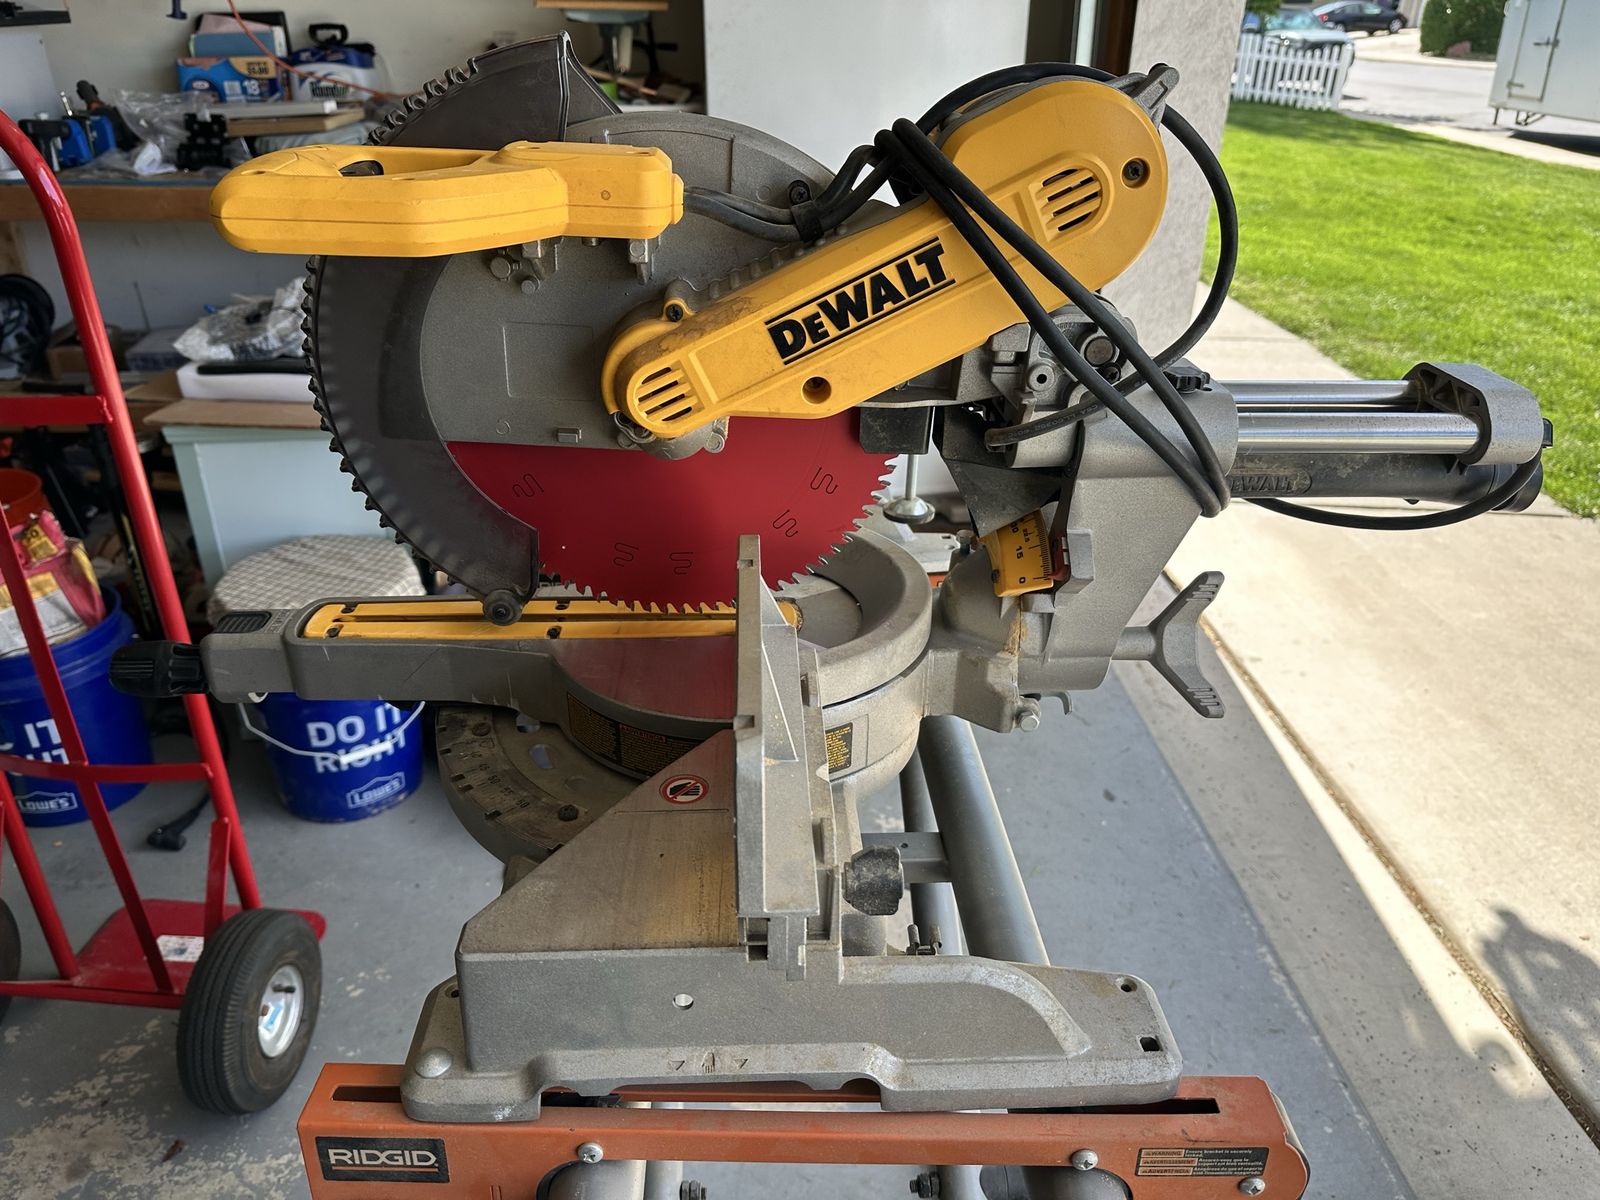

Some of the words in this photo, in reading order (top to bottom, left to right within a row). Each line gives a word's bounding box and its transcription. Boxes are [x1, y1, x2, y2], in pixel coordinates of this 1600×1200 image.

[243, 80, 260, 95] 18
[767, 242, 947, 360] DEWALT
[1015, 545, 1024, 560] 15
[1018, 576, 1026, 585] 0
[306, 715, 367, 748] DO
[328, 1149, 437, 1167] RIDGID
